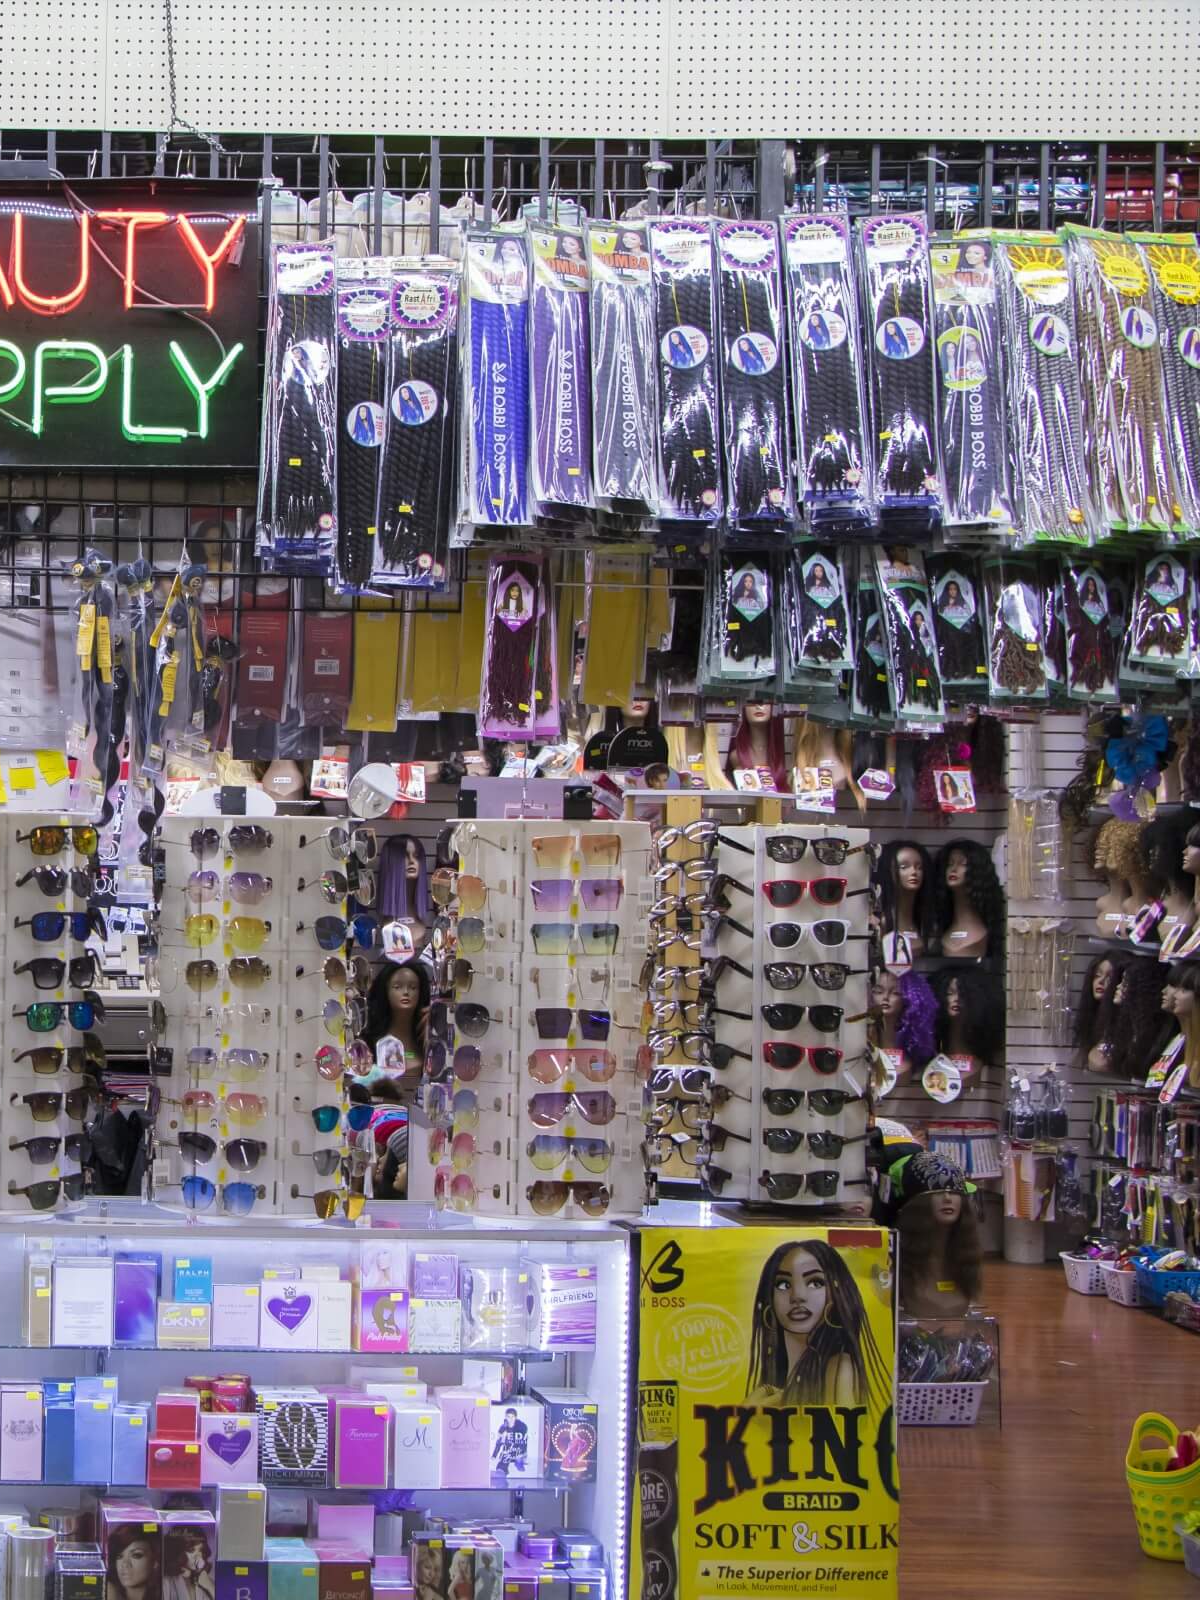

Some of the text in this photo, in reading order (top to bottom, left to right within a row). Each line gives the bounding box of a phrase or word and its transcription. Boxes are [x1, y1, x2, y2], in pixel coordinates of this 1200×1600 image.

[560, 373, 573, 453] BOBBI BOSS
[493, 385, 506, 469] BOBBI BOSS
[623, 412, 637, 448] BOSS
[971, 431, 986, 468] BOSS
[652, 1297, 686, 1308] BOSS
[162, 1317, 207, 1327] DKNY
[783, 1494, 842, 1509] BRAID
[695, 1523, 787, 1549] SOFT
[792, 1521, 823, 1554] &
[717, 1566, 889, 1583] The Superior Difference
[801, 1584, 817, 1592] and
[820, 1584, 837, 1592] Feel
